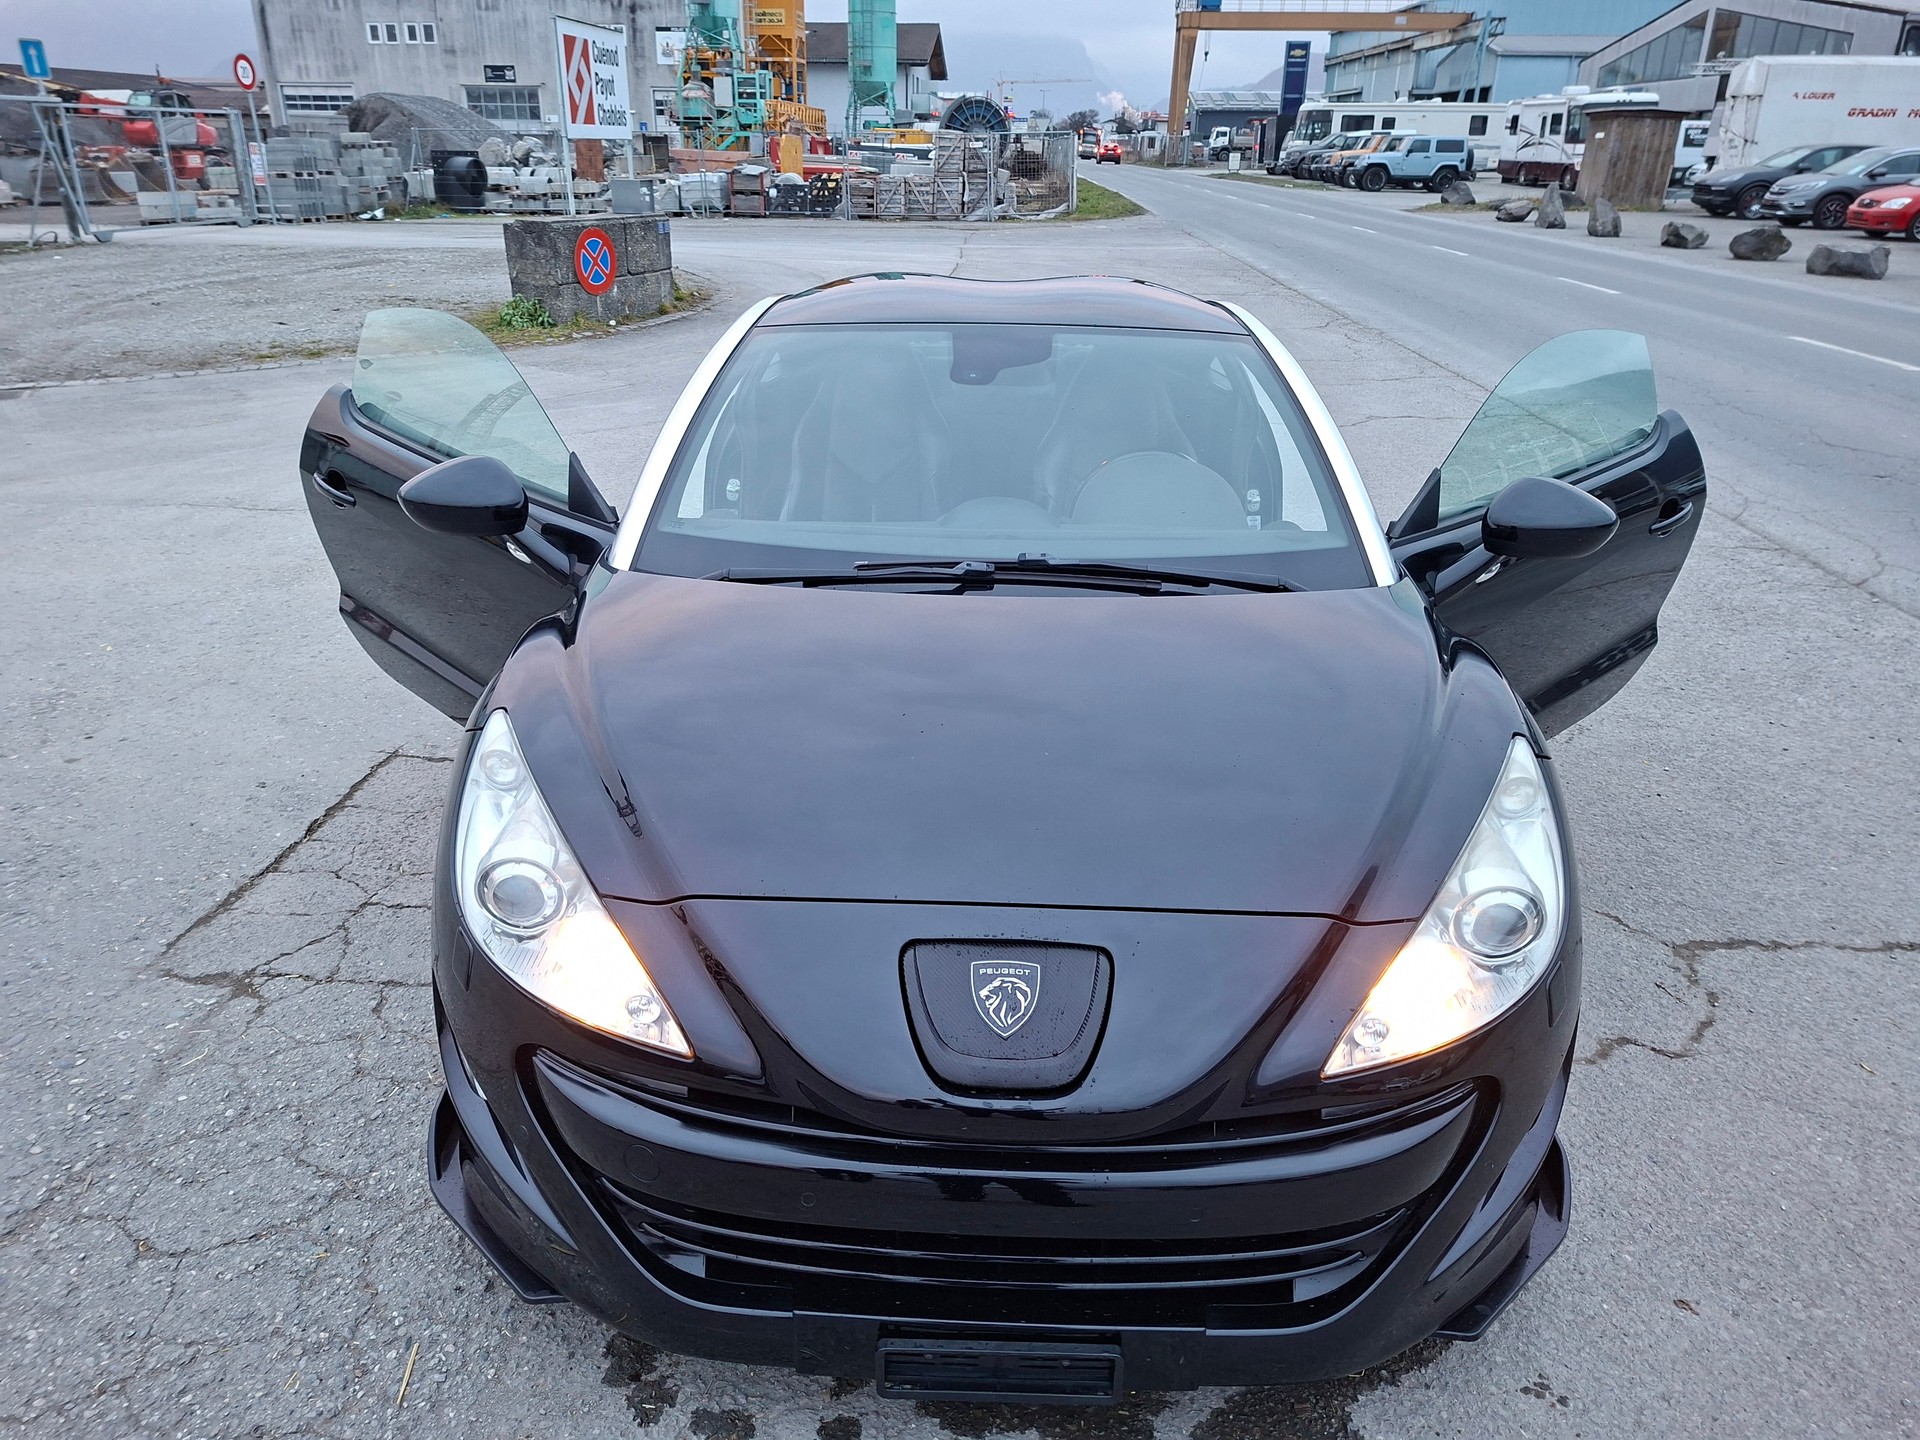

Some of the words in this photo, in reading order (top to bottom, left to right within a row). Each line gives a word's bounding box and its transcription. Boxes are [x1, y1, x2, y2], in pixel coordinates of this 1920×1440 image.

[595, 72, 616, 100] Payot
[1802, 92, 1835, 100] LOUER
[598, 103, 628, 127] Chablais
[1907, 108, 1920, 118] M
[979, 967, 1031, 976] PEUGEOT
